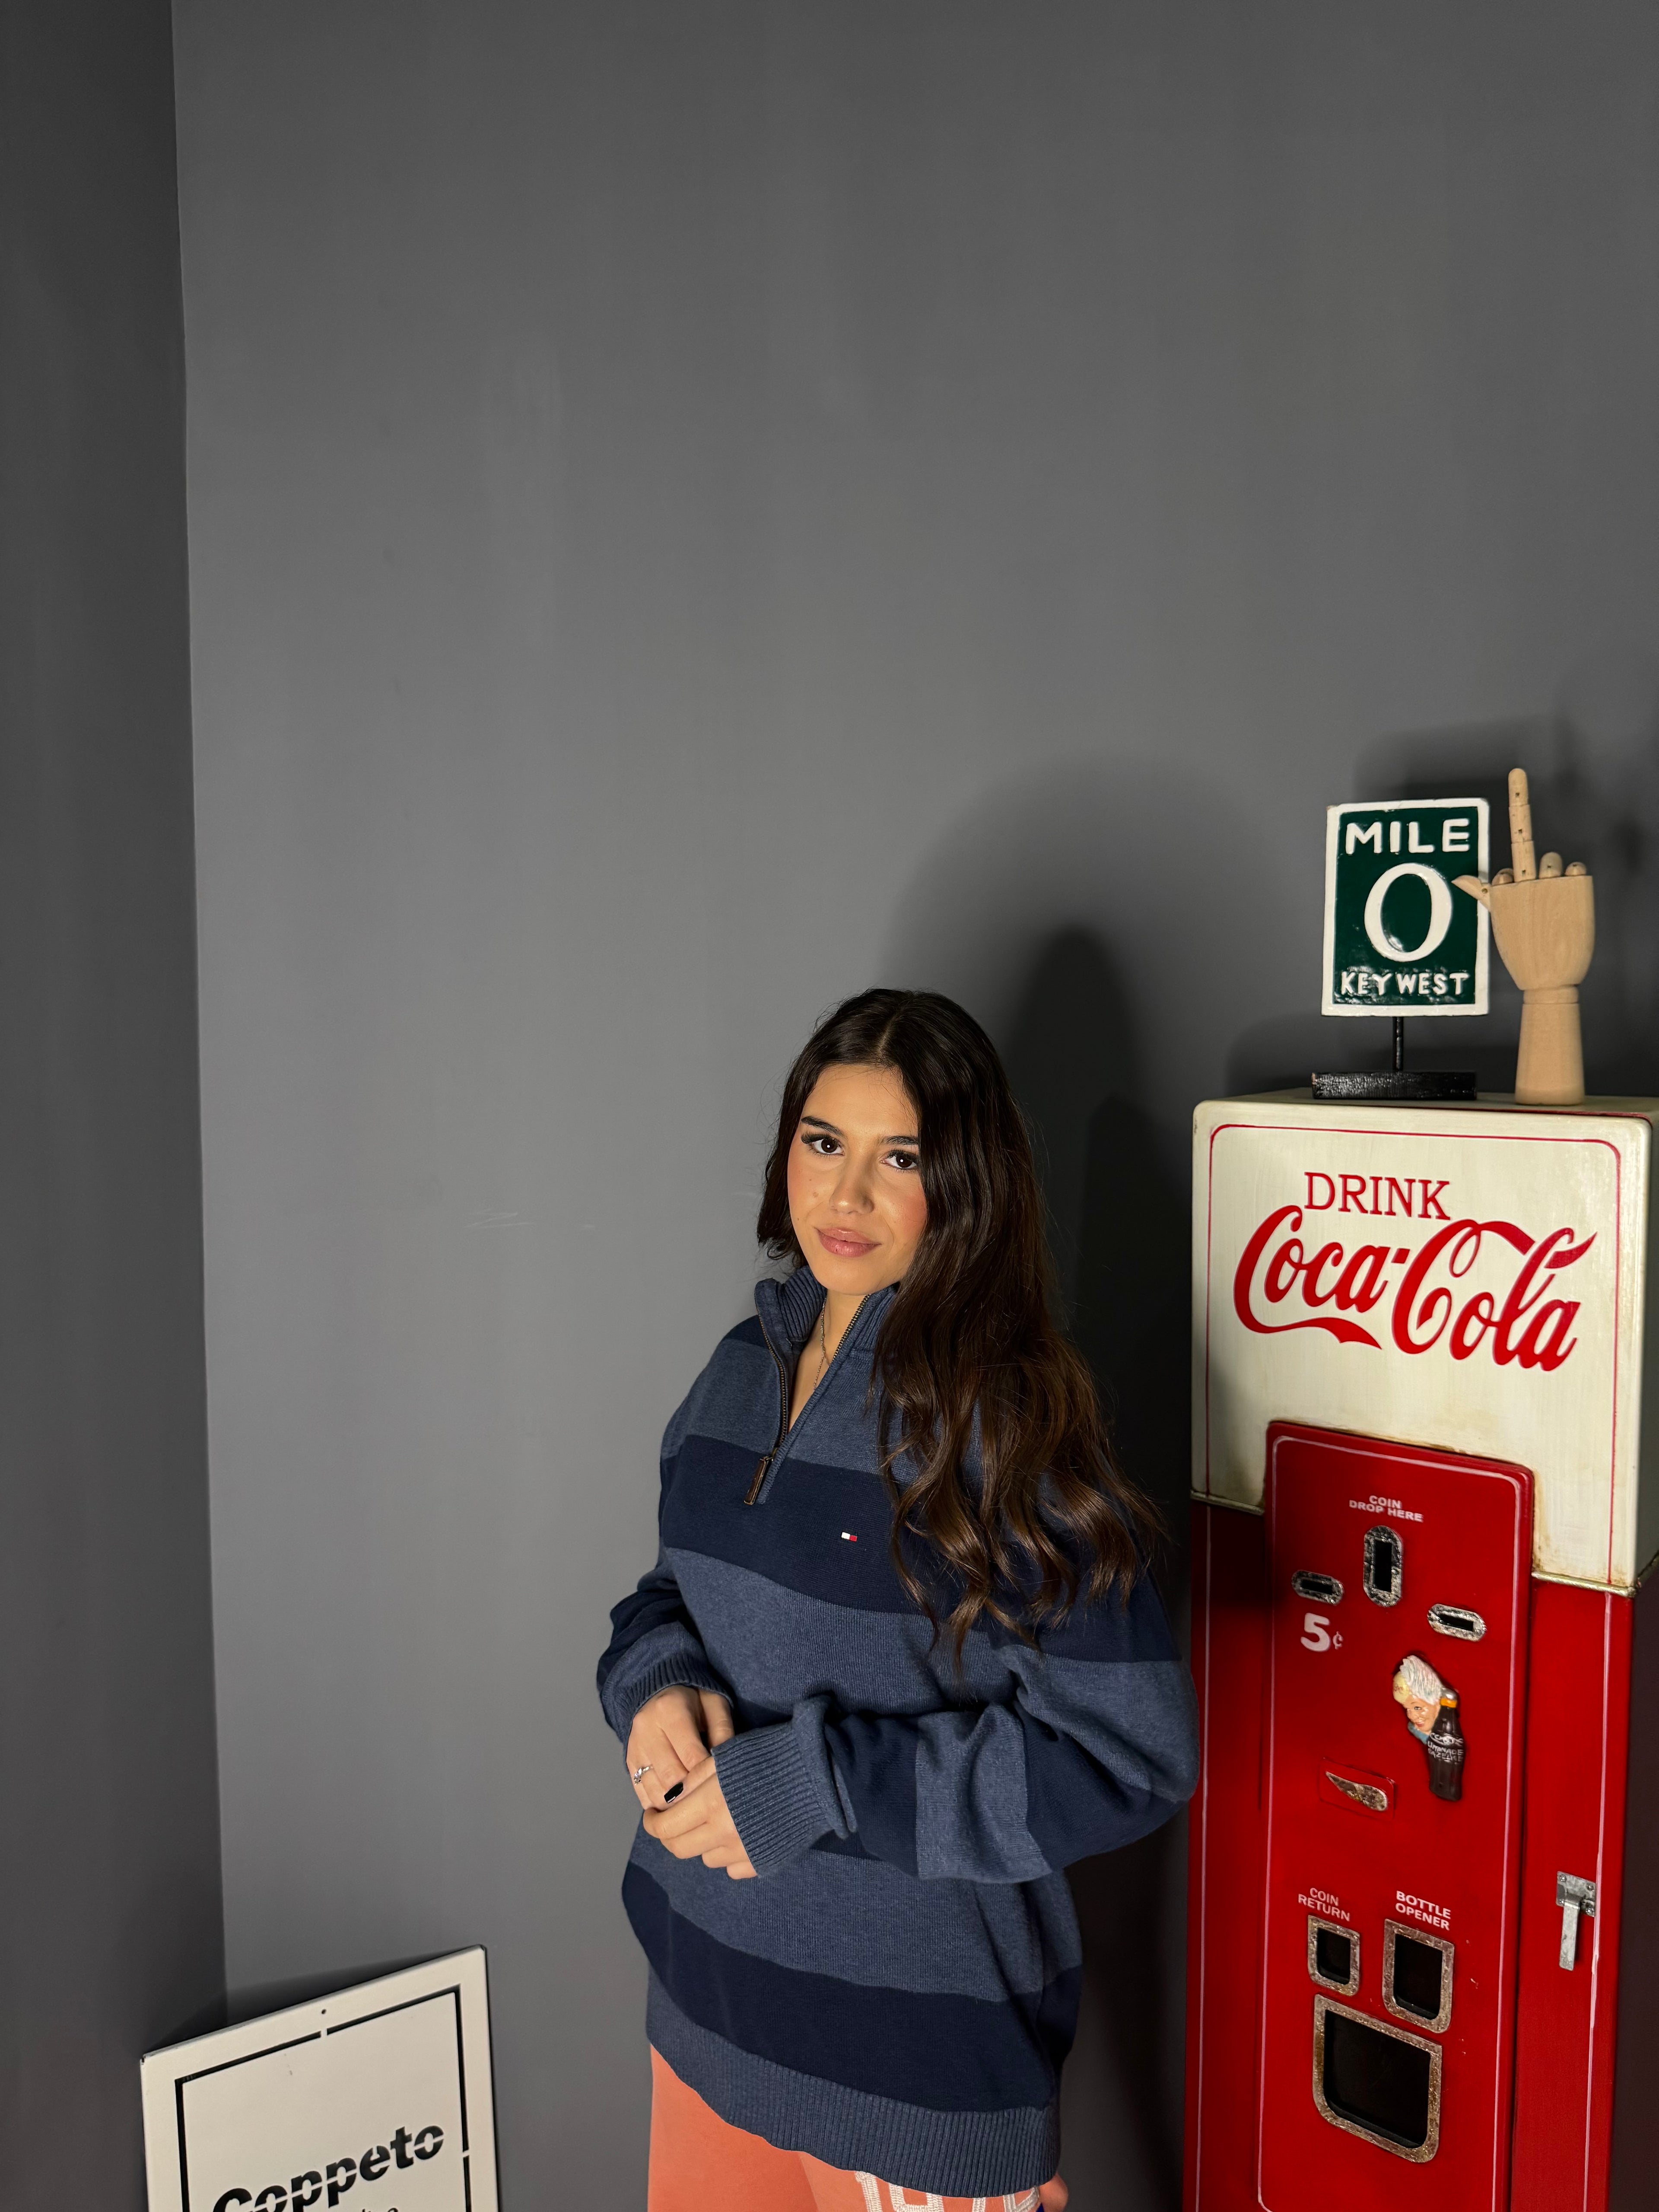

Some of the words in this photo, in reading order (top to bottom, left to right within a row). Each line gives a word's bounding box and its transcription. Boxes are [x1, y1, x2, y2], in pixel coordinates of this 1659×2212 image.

[1346, 819, 1469, 855] MILE
[1341, 971, 1393, 995] KEY
[1396, 972, 1468, 995] WEST
[1304, 1172, 1450, 1220] DRINK
[1233, 1205, 1597, 1371] Coca-Cola
[1349, 1500, 1384, 1513] DROP
[1388, 1508, 1424, 1522] HERE
[1369, 1495, 1402, 1509] COIN
[1298, 1894, 1350, 1922] RETURN
[1310, 1888, 1338, 1906] COIN
[1396, 1891, 1451, 1919] BOTTLE
[1395, 1903, 1449, 1930] OPENER
